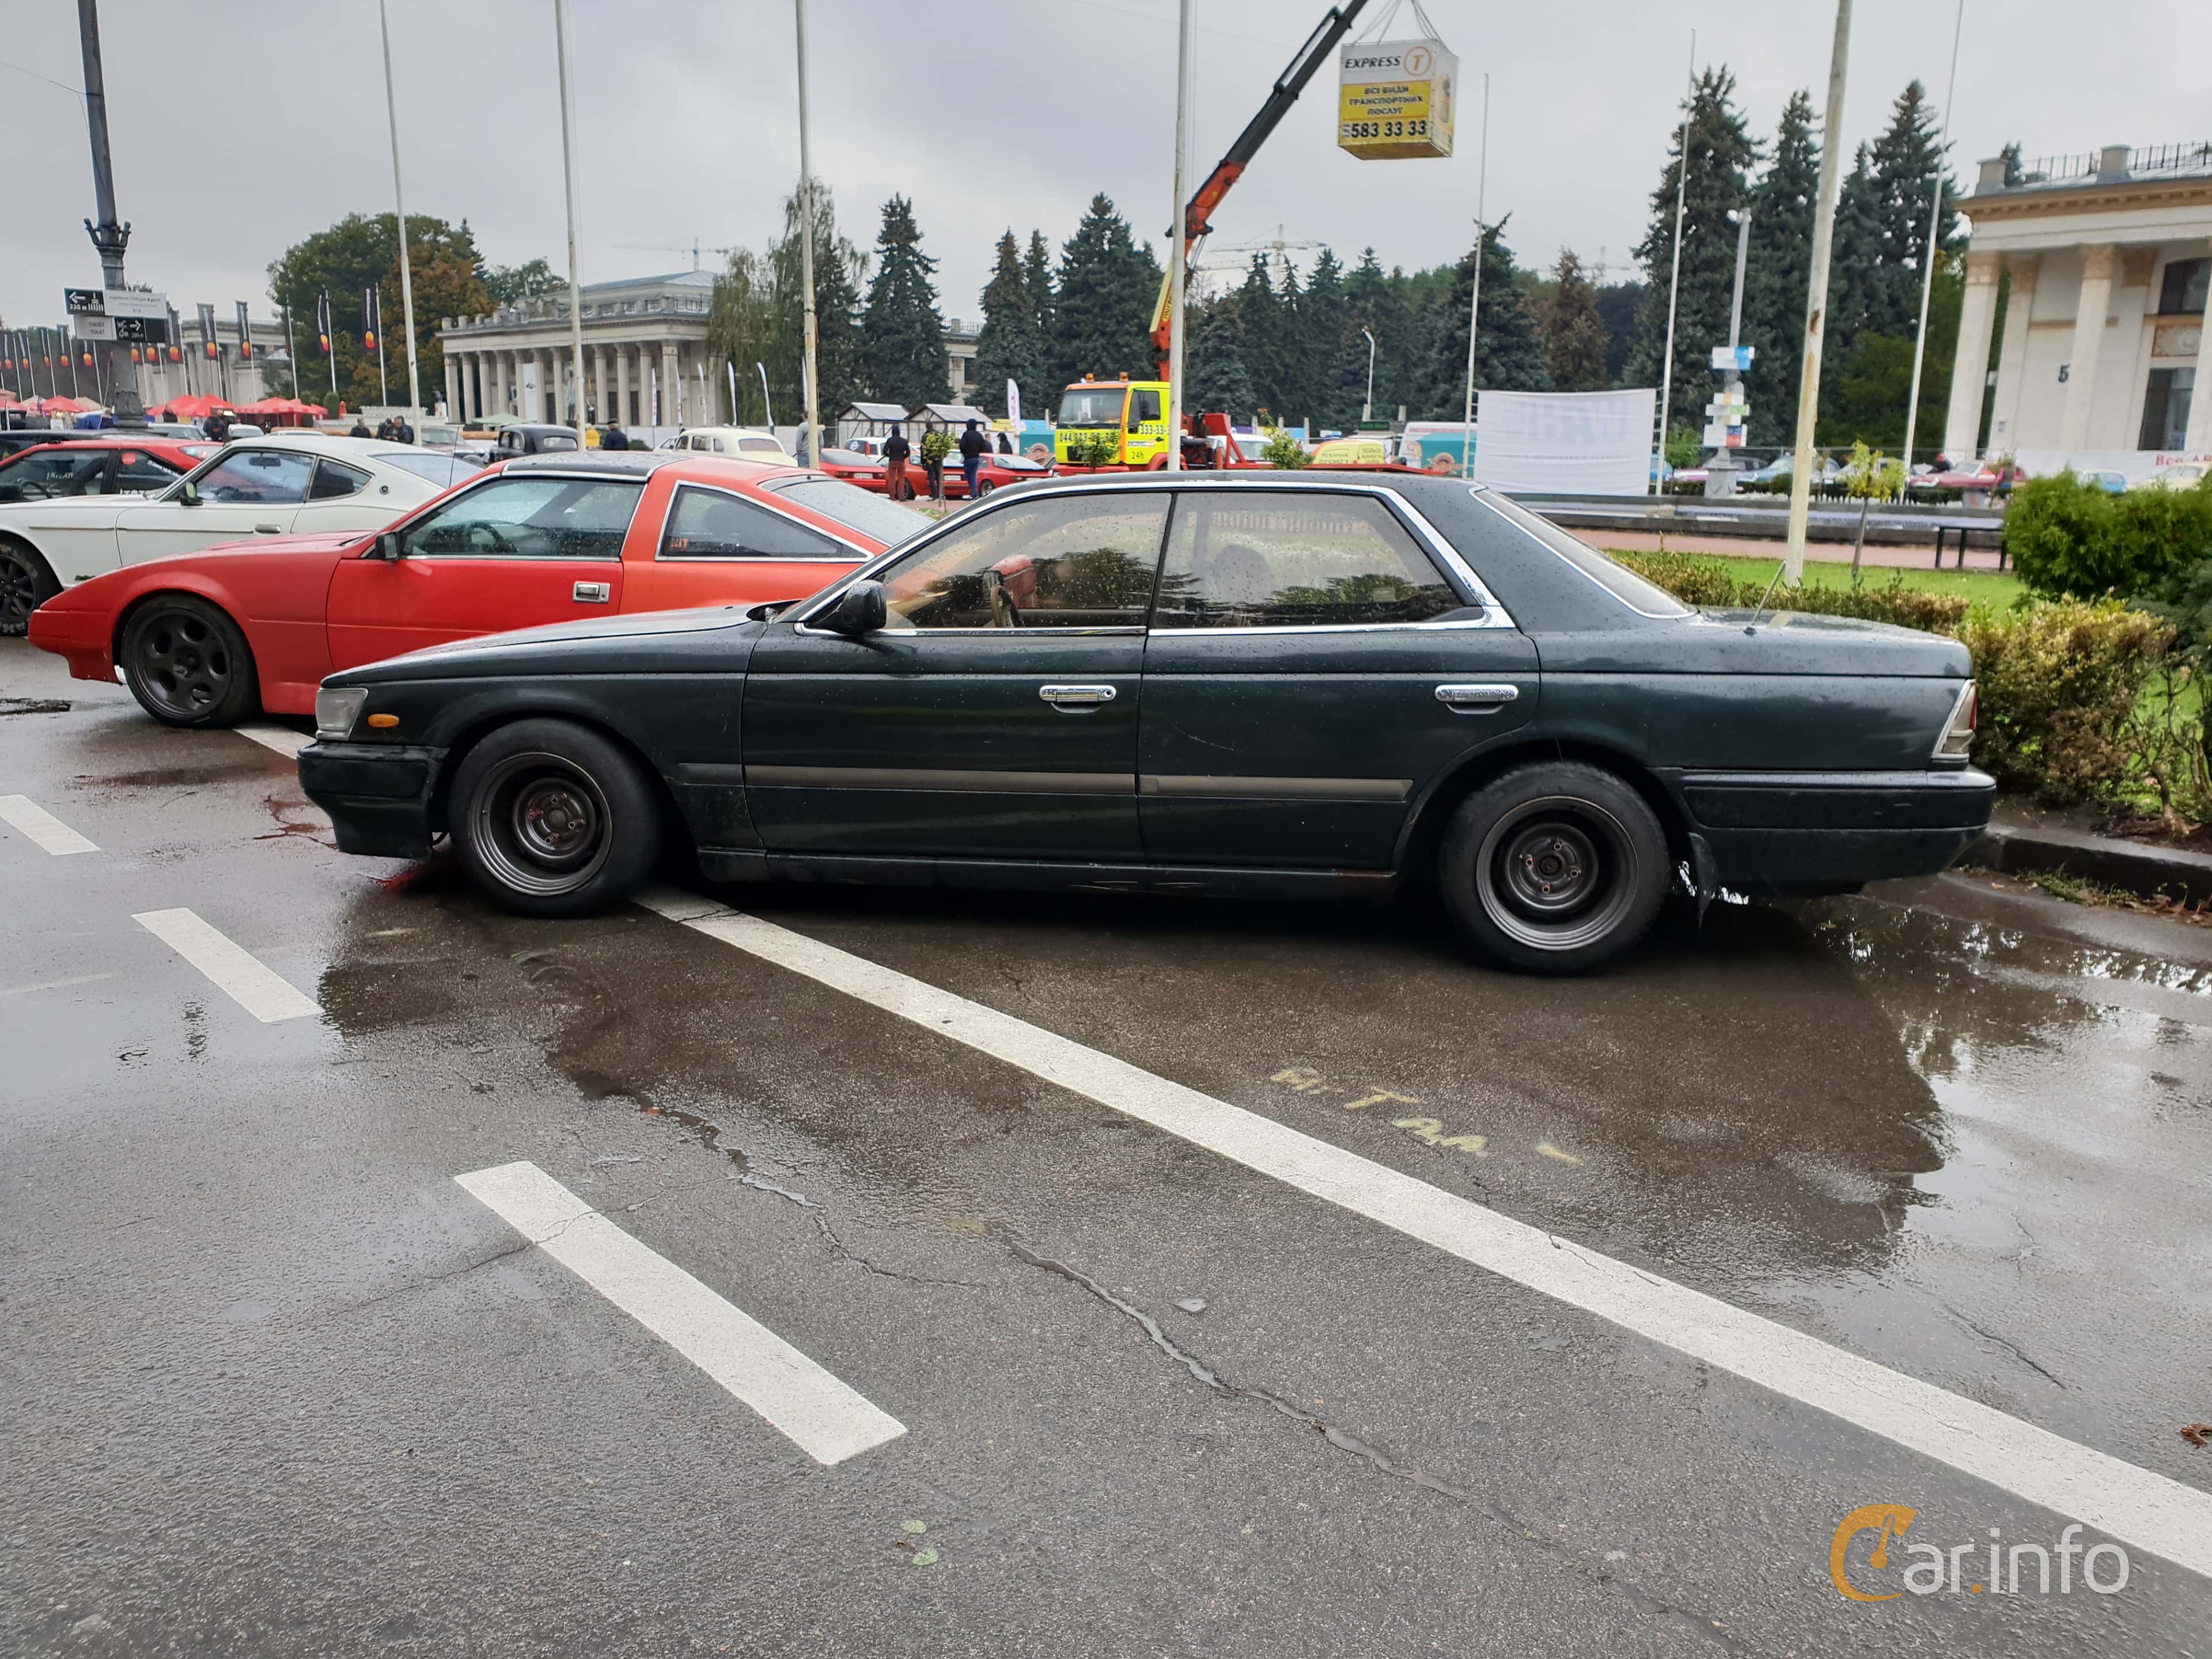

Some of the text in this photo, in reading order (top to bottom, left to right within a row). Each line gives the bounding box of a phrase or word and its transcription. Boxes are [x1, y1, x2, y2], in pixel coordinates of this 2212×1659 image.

[1345, 55, 1402, 69] EXPRESS
[1351, 122, 1379, 138] 583
[1384, 121, 1403, 137] 33
[1407, 120, 1426, 136] 33
[2058, 363, 2071, 383] 5
[1131, 451, 1144, 460] 24h
